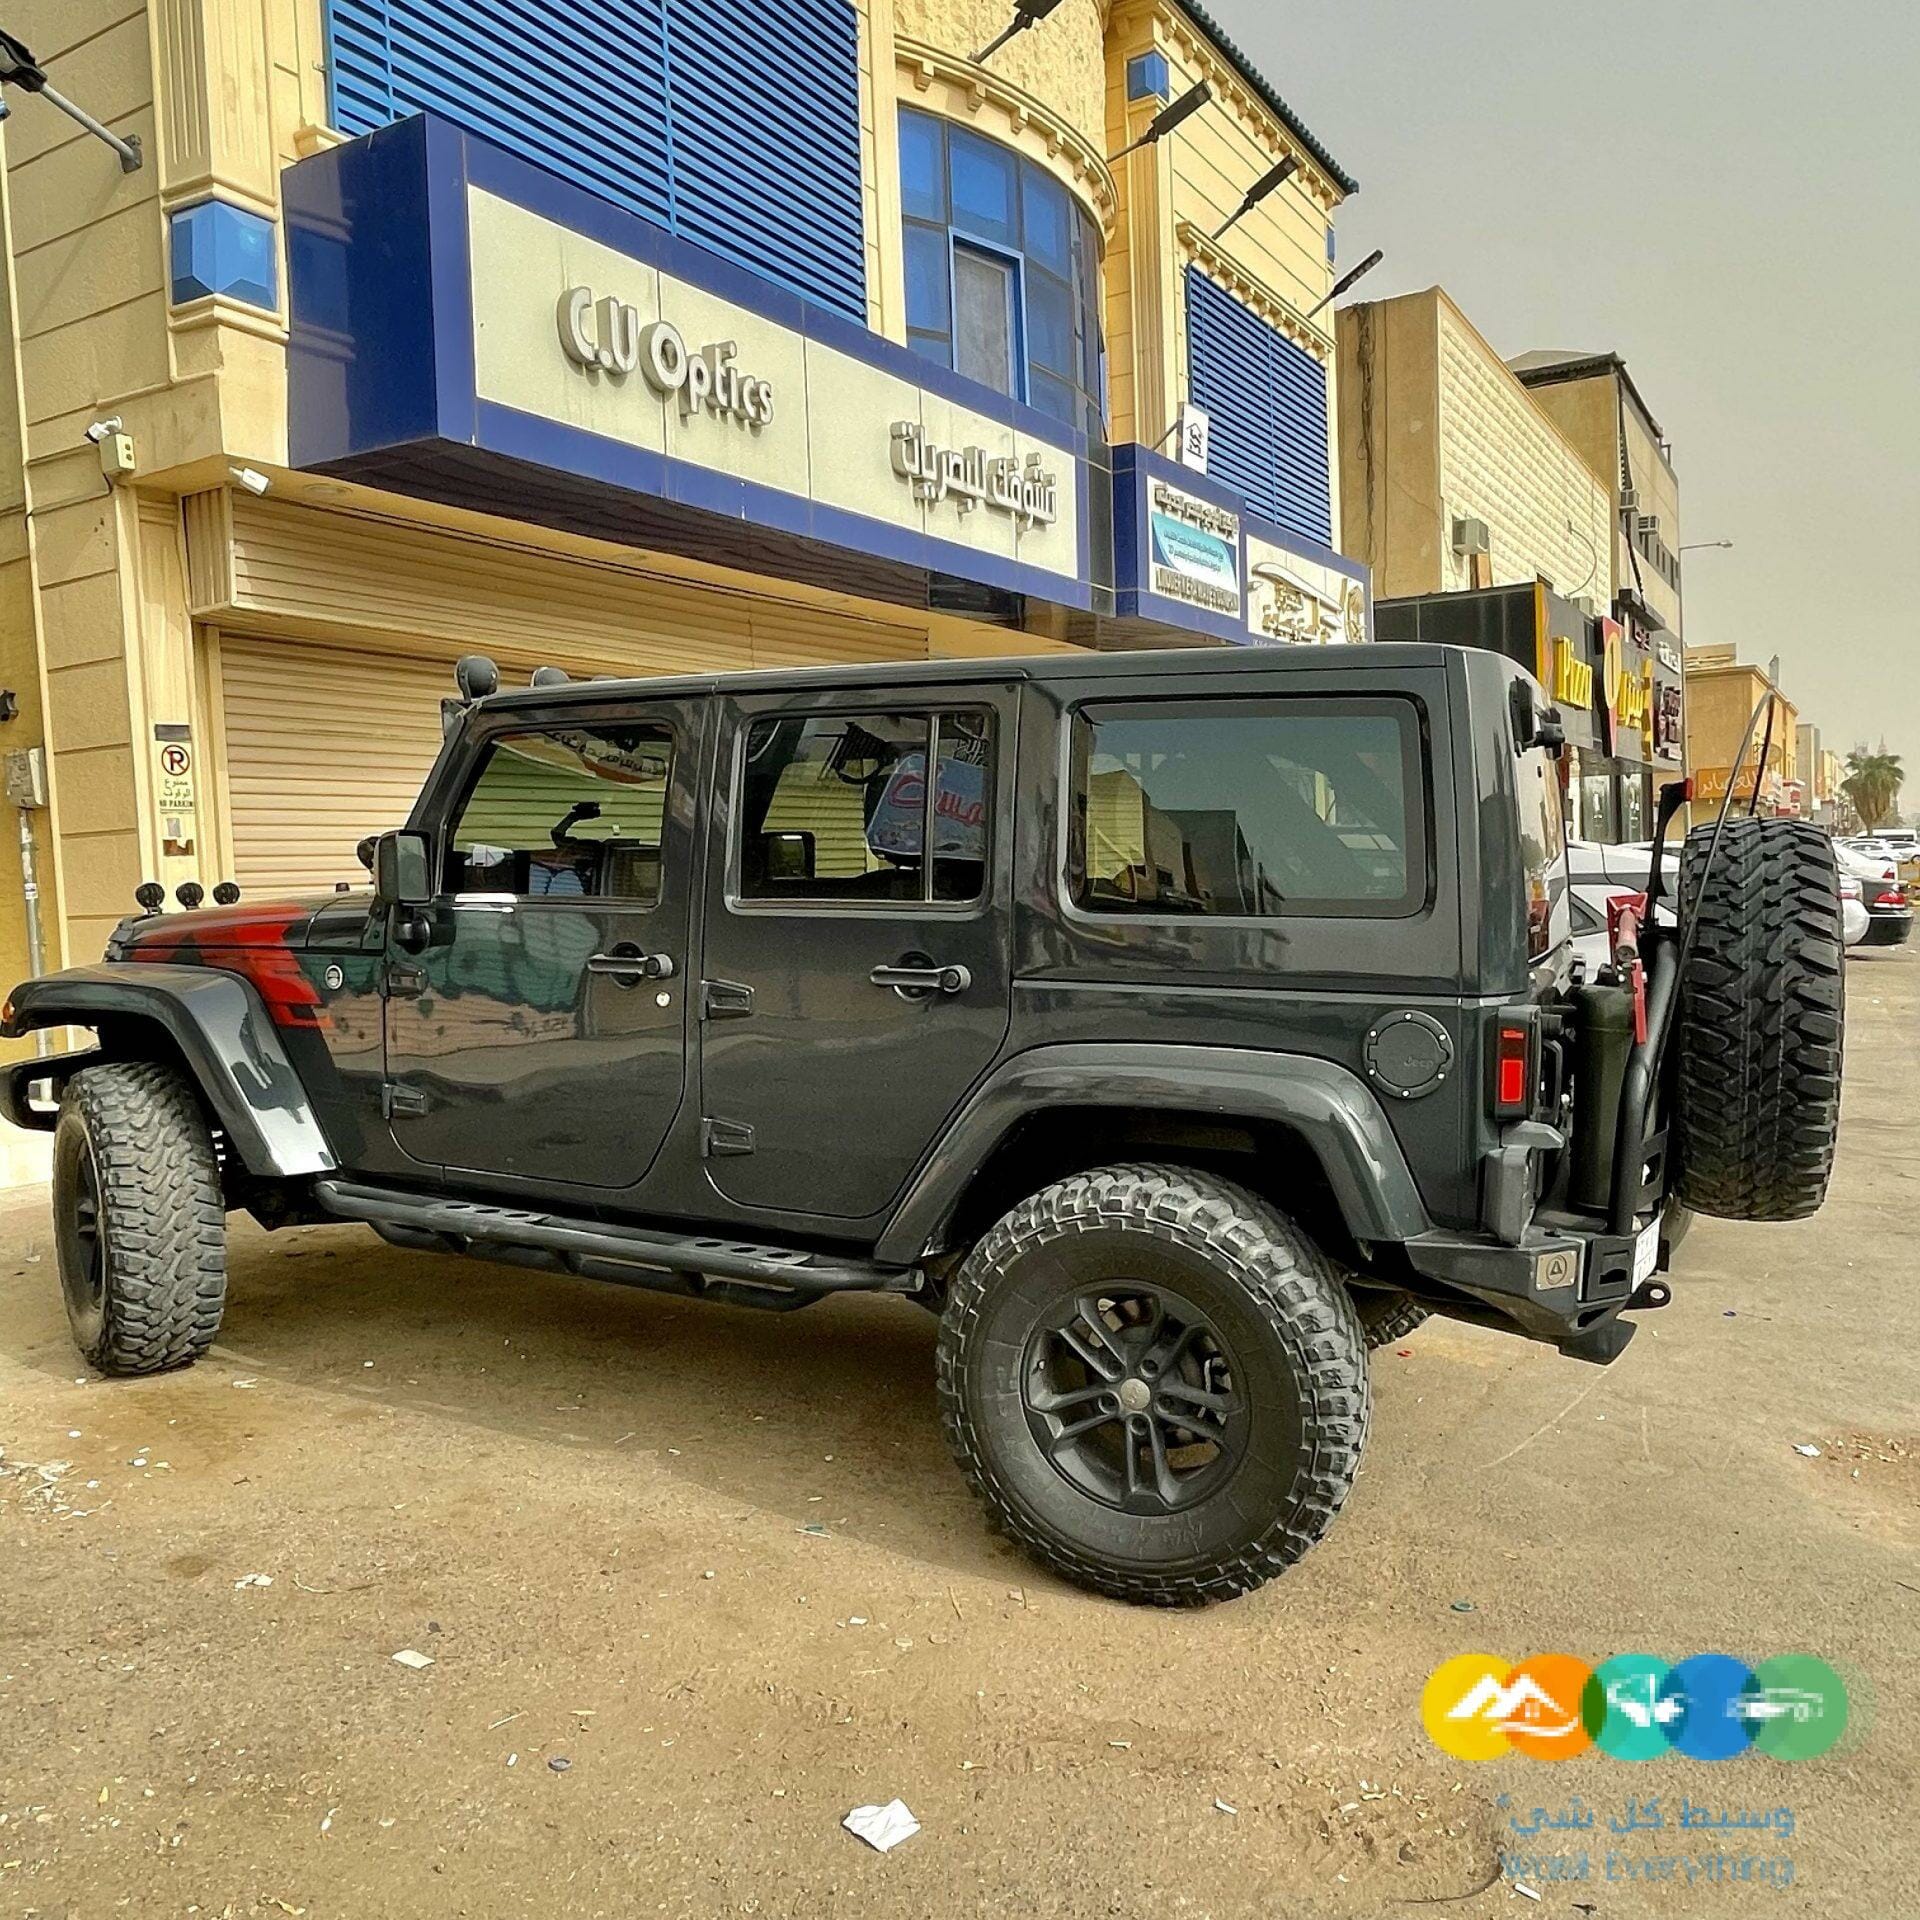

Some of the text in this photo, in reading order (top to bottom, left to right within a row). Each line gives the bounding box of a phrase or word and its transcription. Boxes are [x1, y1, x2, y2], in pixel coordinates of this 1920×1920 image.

[557, 285, 774, 426] C.U Optics
[1553, 635, 1593, 711] Pizza
[1403, 1055, 1434, 1070] Jeep
